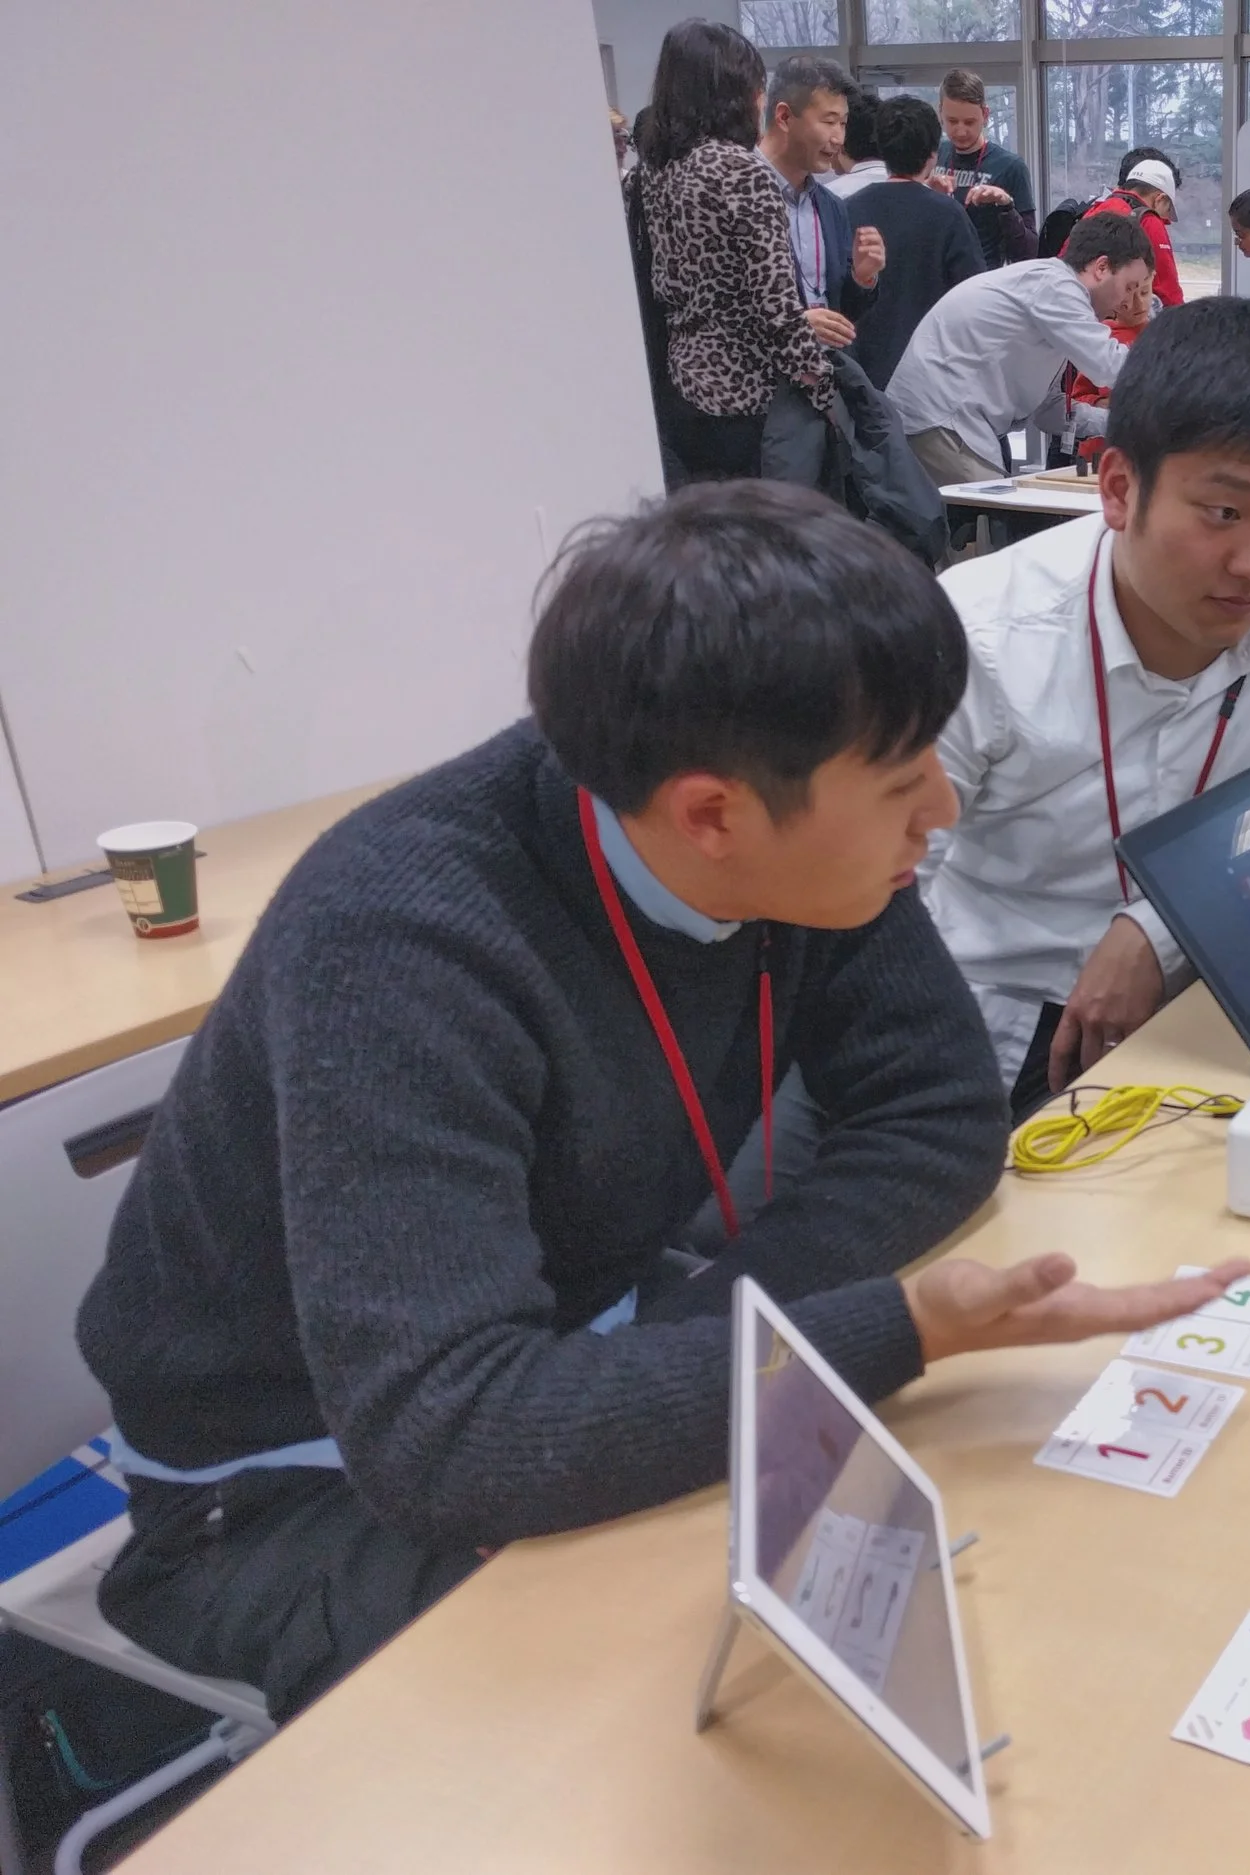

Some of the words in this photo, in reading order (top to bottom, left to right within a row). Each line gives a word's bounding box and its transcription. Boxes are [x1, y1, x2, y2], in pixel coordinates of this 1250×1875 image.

[1176, 1333, 1226, 1355] 3
[1135, 1387, 1190, 1415] 2
[1097, 1443, 1151, 1460] 1
